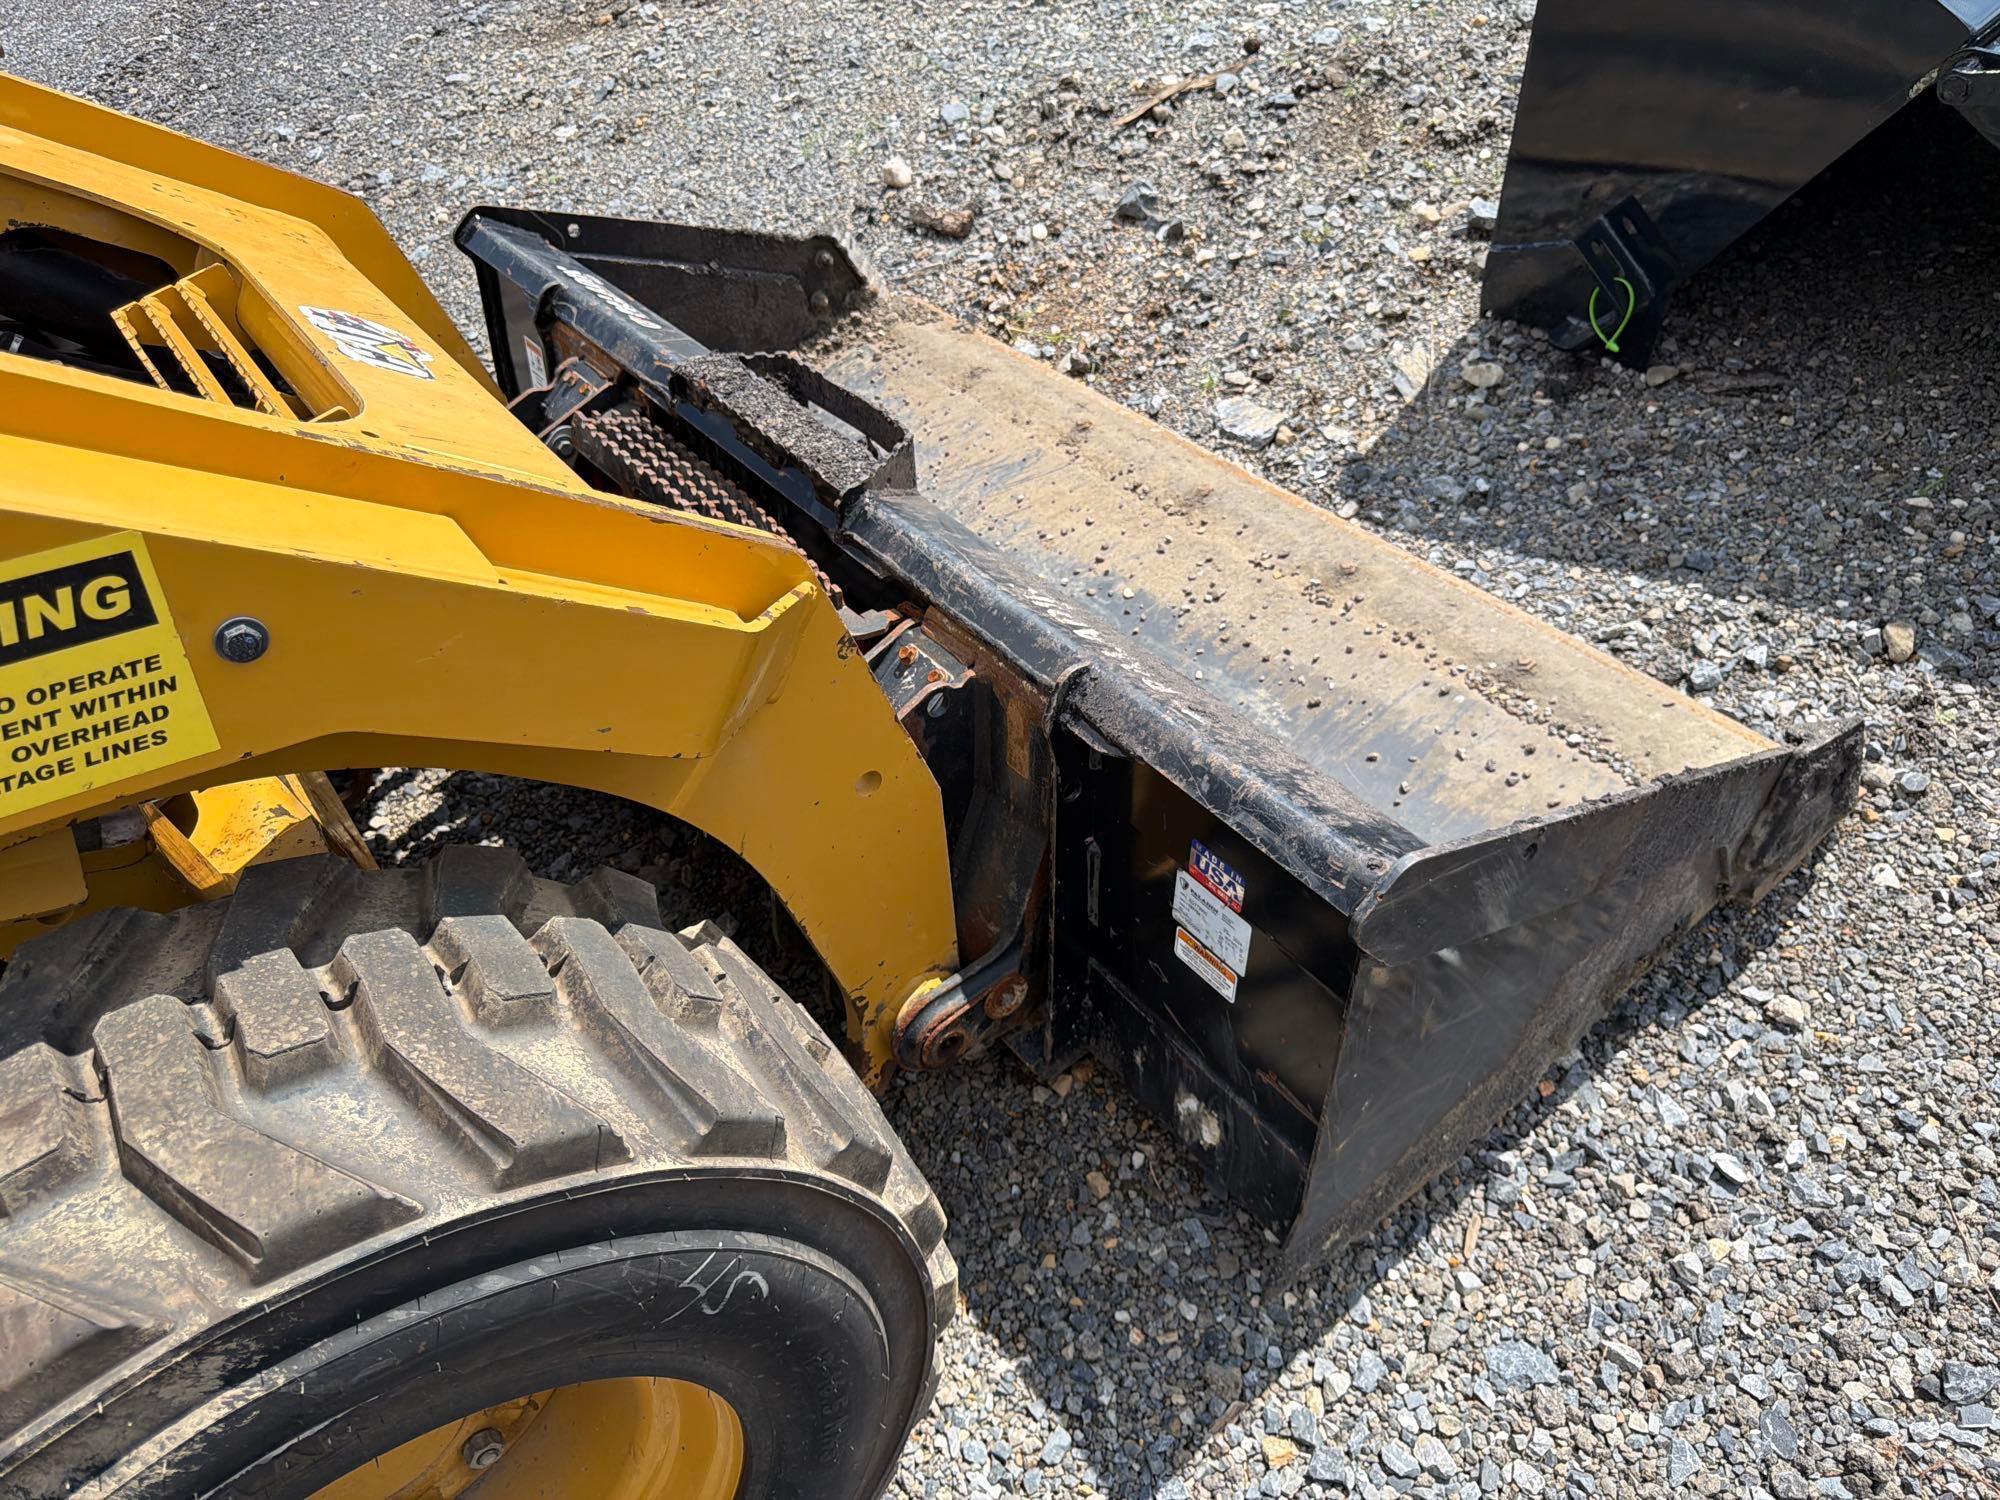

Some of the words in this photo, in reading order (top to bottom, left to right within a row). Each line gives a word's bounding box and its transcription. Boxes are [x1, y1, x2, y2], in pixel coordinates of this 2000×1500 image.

[1, 708, 62, 741] ENT
[70, 675, 177, 720] WITHIN
[26, 653, 163, 706] OPERATE
[0, 757, 76, 794] TAGE
[84, 729, 169, 768] LINES
[11, 704, 170, 763] OVERHEAD
[1195, 852, 1241, 903] USA
